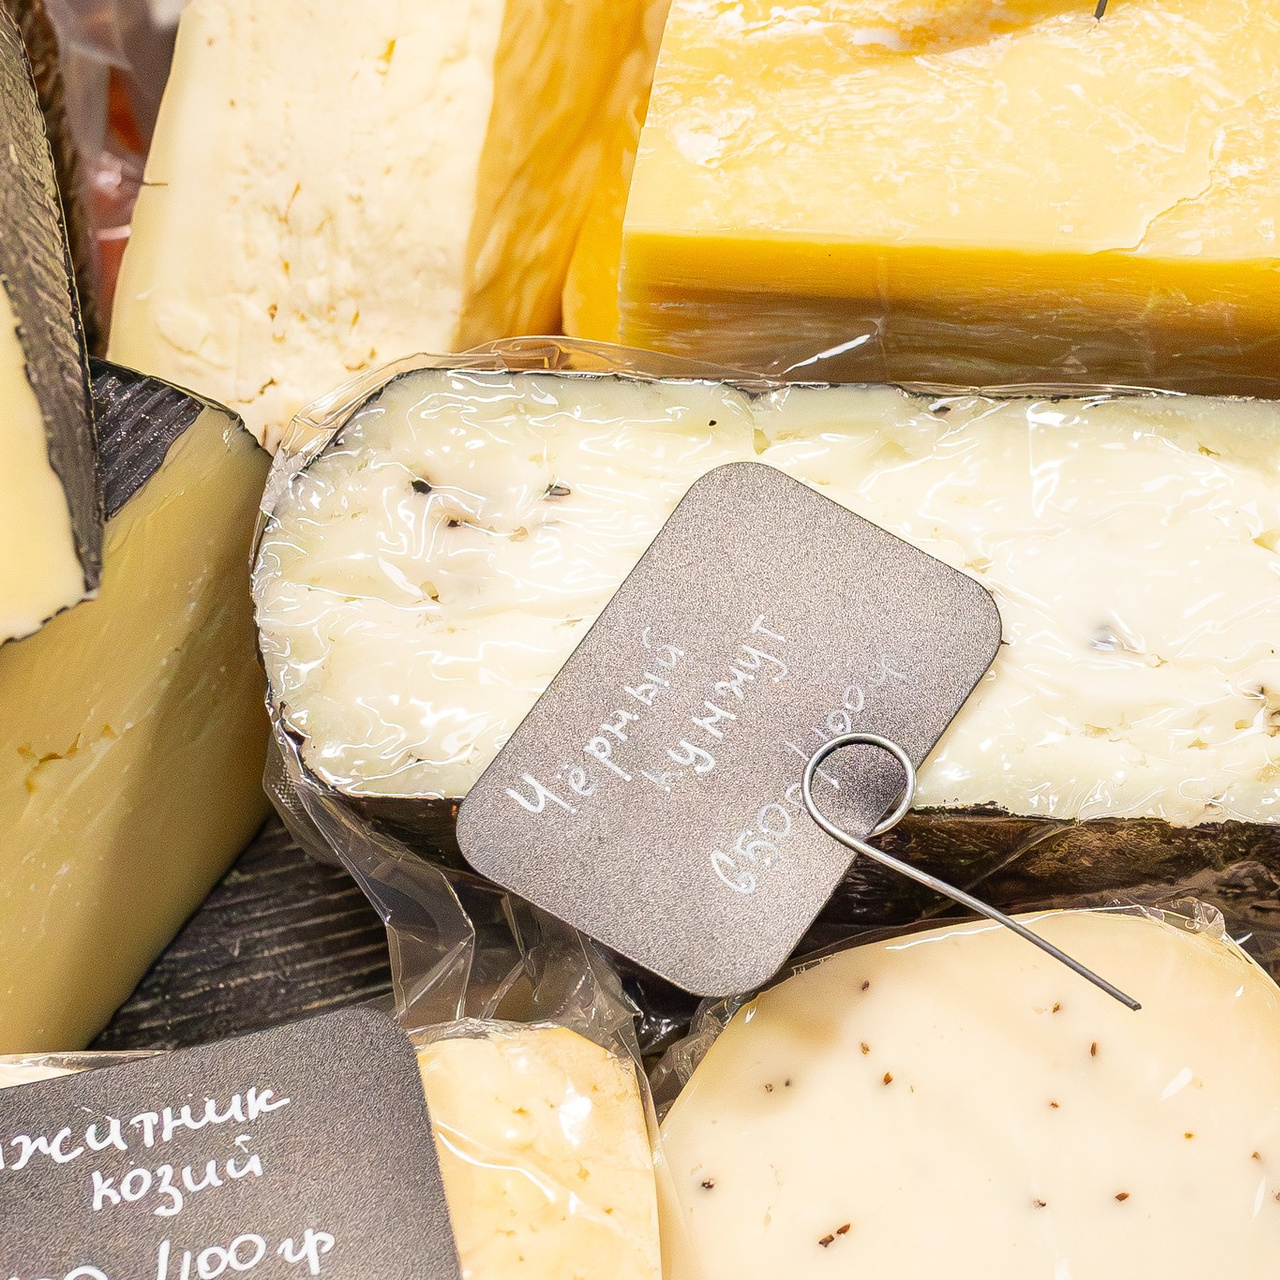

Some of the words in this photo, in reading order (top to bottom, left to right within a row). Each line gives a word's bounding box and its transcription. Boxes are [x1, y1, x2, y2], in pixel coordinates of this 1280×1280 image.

[505, 625, 685, 816] Чёрный
[641, 612, 789, 793] кунжут
[0, 1086, 291, 1171] житник
[91, 1135, 263, 1217] козий
